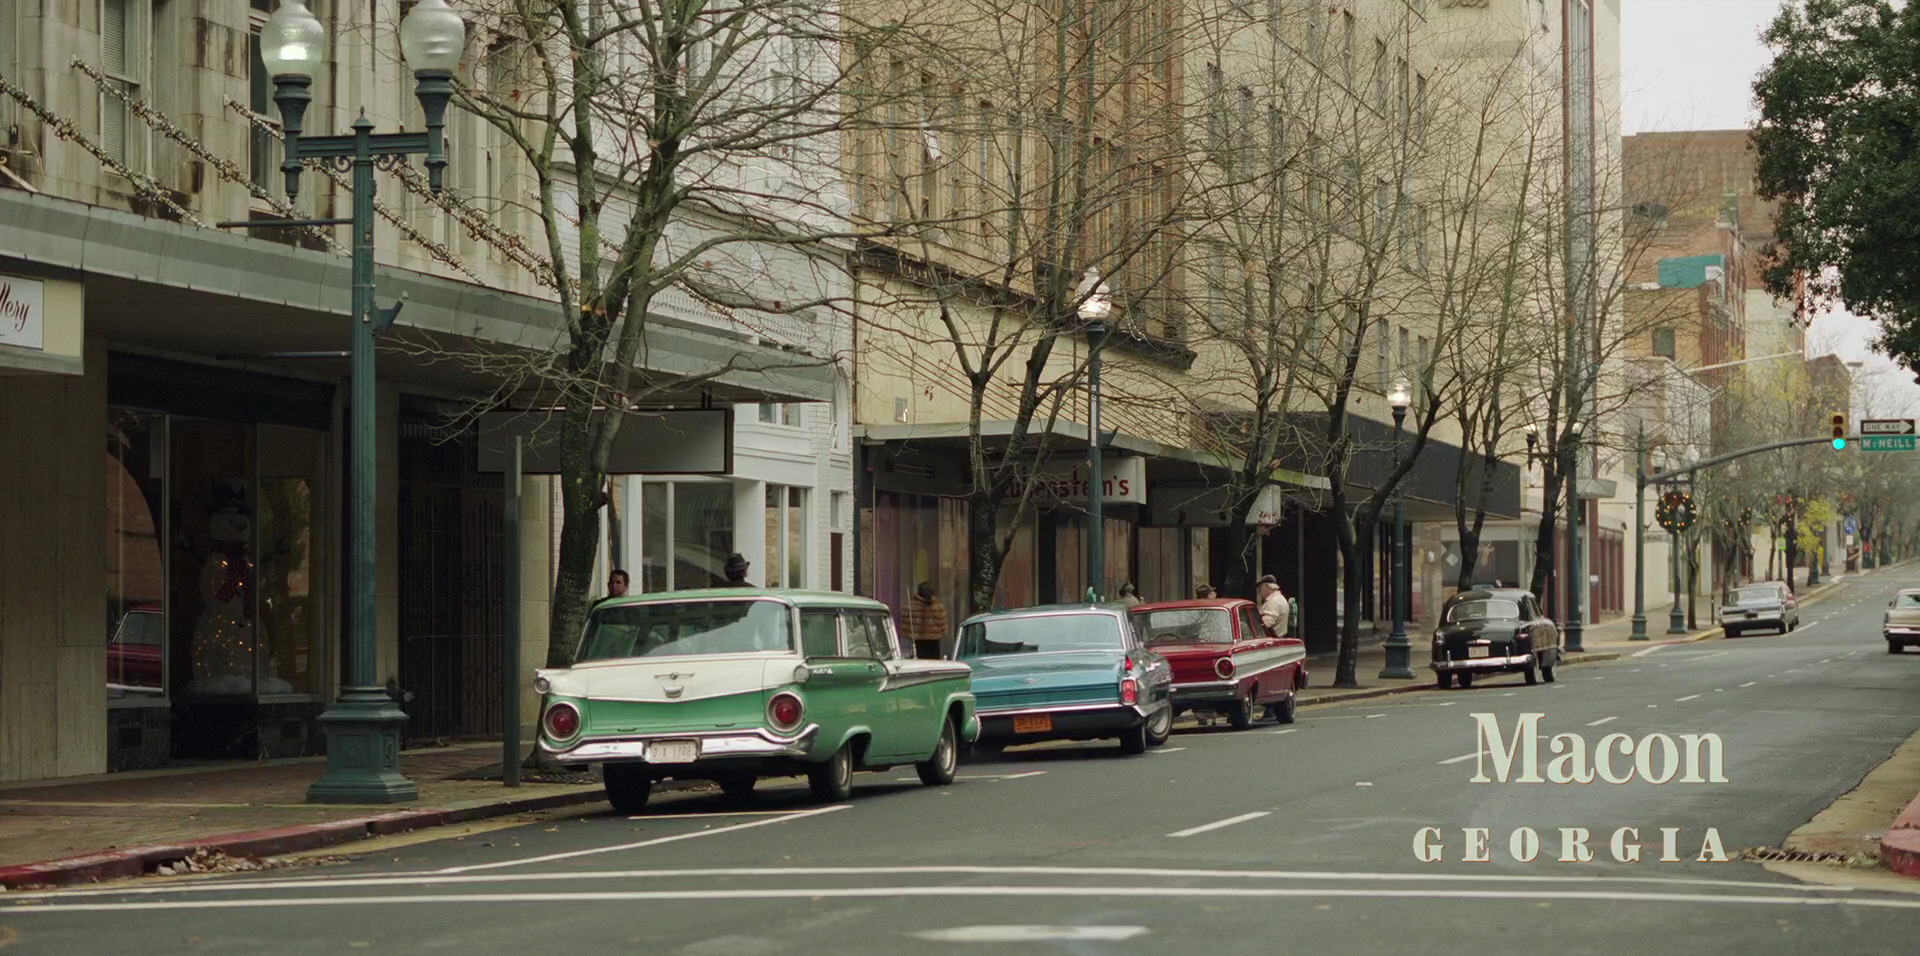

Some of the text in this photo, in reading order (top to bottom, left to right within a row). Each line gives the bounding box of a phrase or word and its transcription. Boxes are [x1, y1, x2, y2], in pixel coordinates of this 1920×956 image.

[1865, 423, 1900, 431] ONE WAY
[1862, 438, 1913, 449] McNEILL
